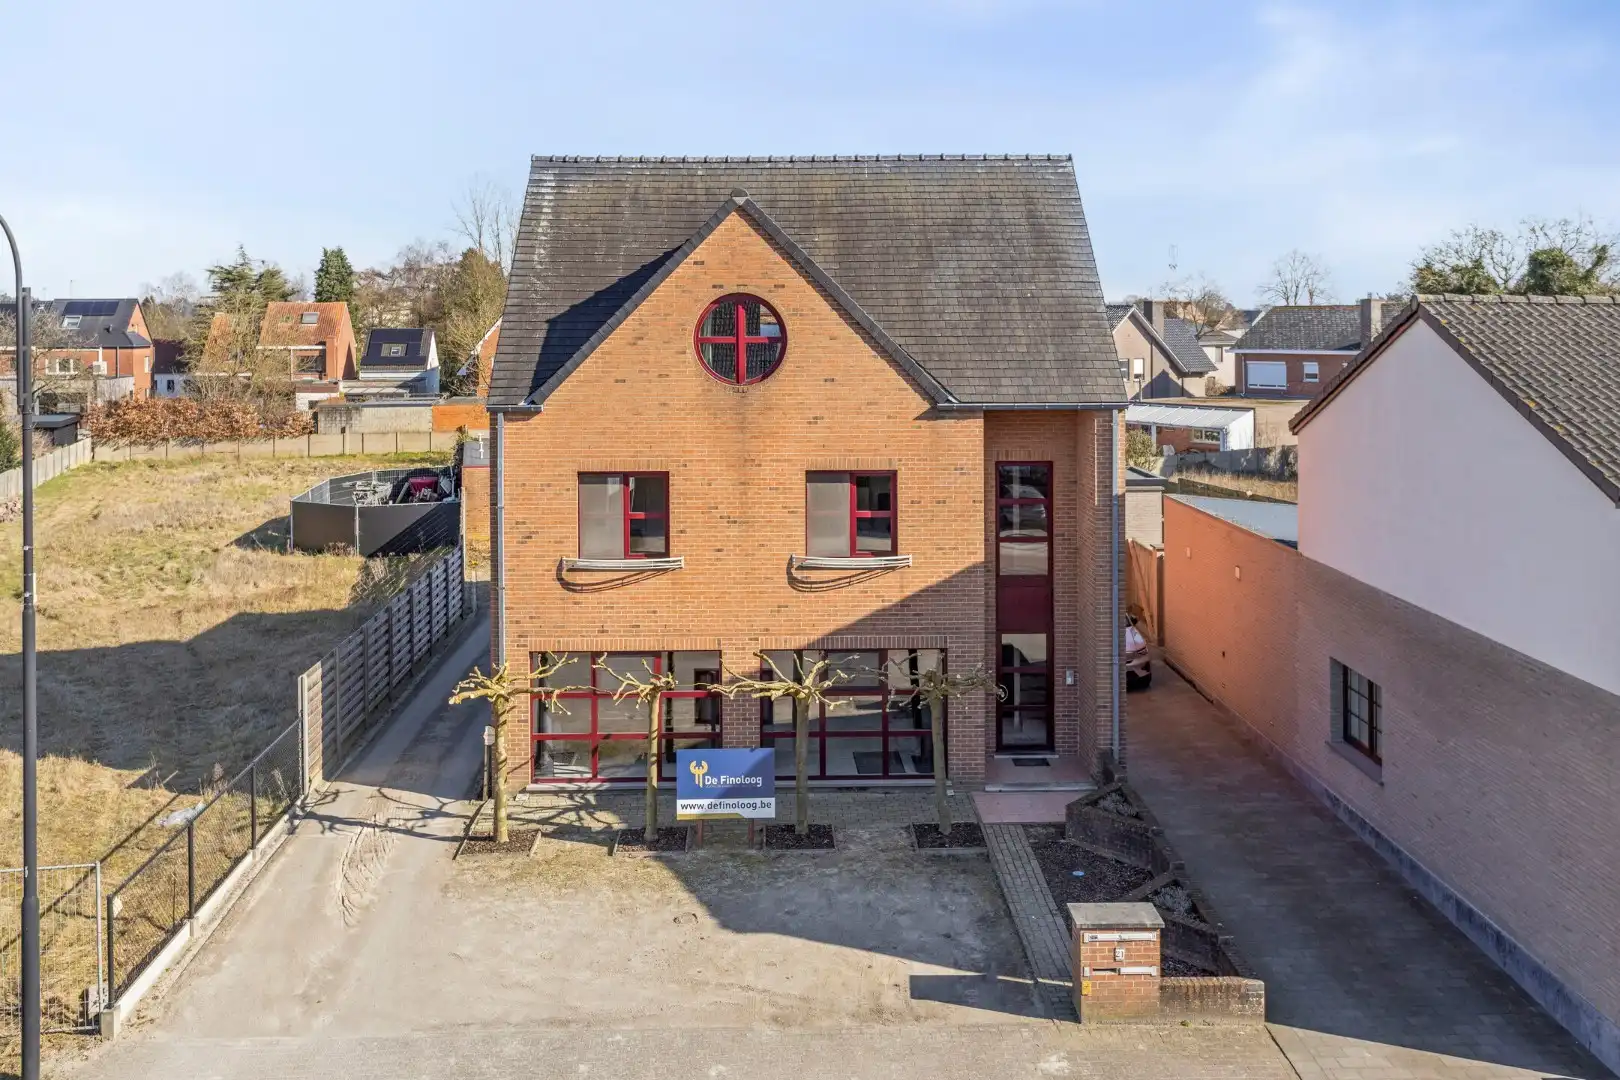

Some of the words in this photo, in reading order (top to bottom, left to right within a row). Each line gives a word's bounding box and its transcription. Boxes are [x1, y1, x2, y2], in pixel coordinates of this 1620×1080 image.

[705, 776, 718, 785] De
[721, 775, 762, 787] Finoloog
[680, 801, 772, 810] www.definoloog.be
